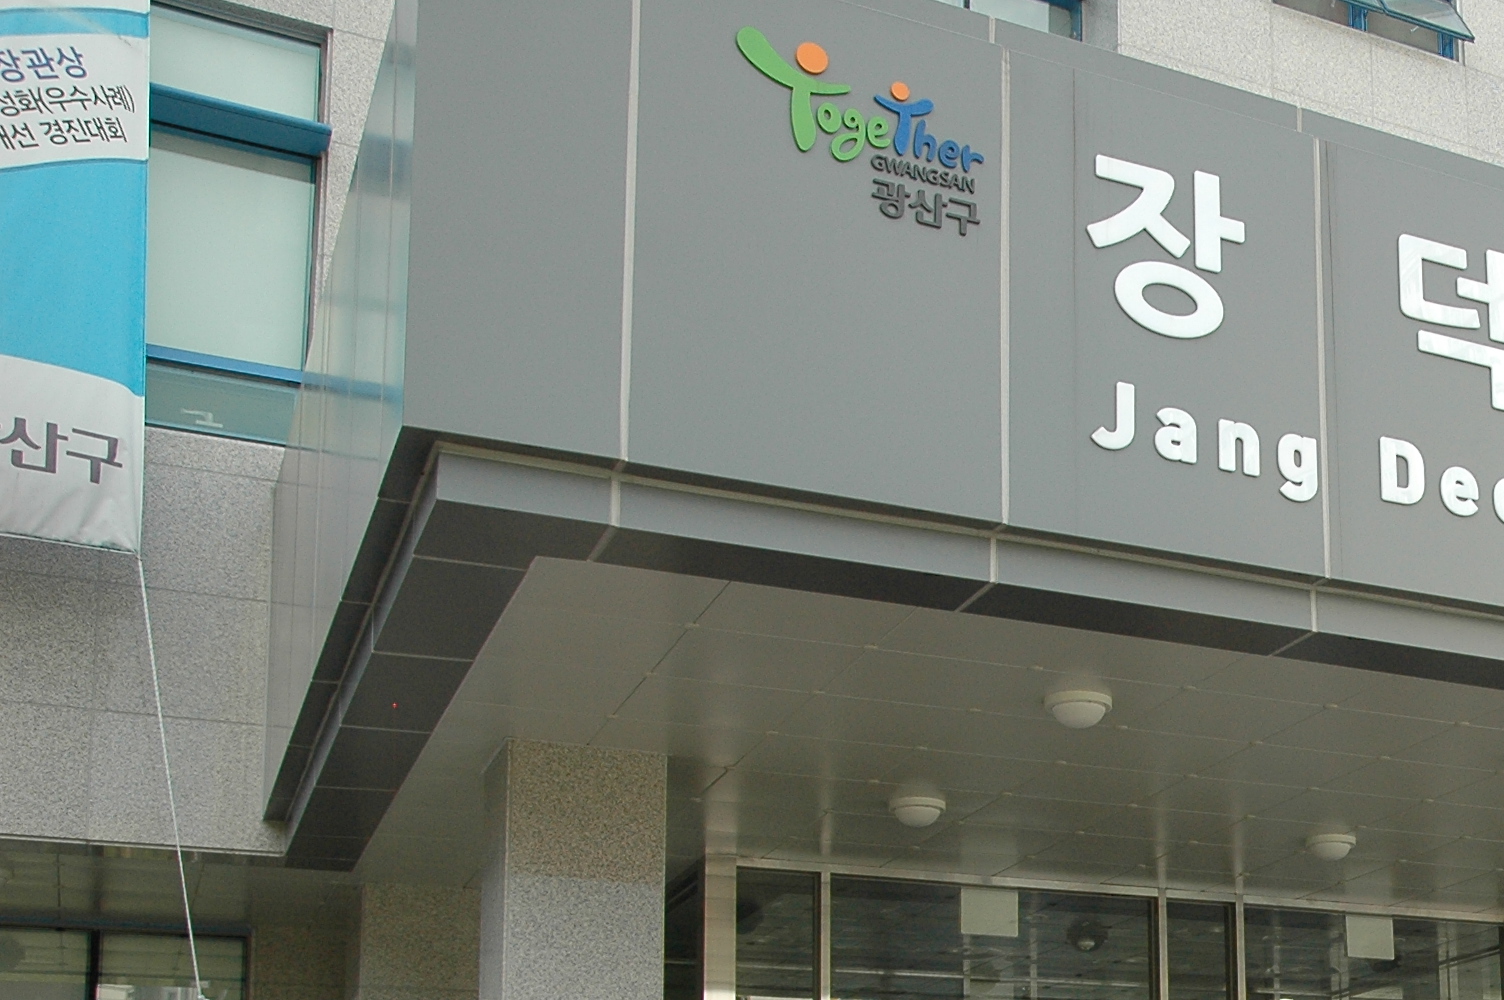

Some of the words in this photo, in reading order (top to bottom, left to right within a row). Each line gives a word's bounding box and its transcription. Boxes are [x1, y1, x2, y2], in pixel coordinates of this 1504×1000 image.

[0, 46, 87, 82] 장관상
[39, 116, 128, 145] 경진대회
[870, 153, 977, 194] GWANGSAN
[870, 177, 981, 237] 광산구
[0, 416, 123, 485] 산구
[1089, 380, 1320, 503] Jang
